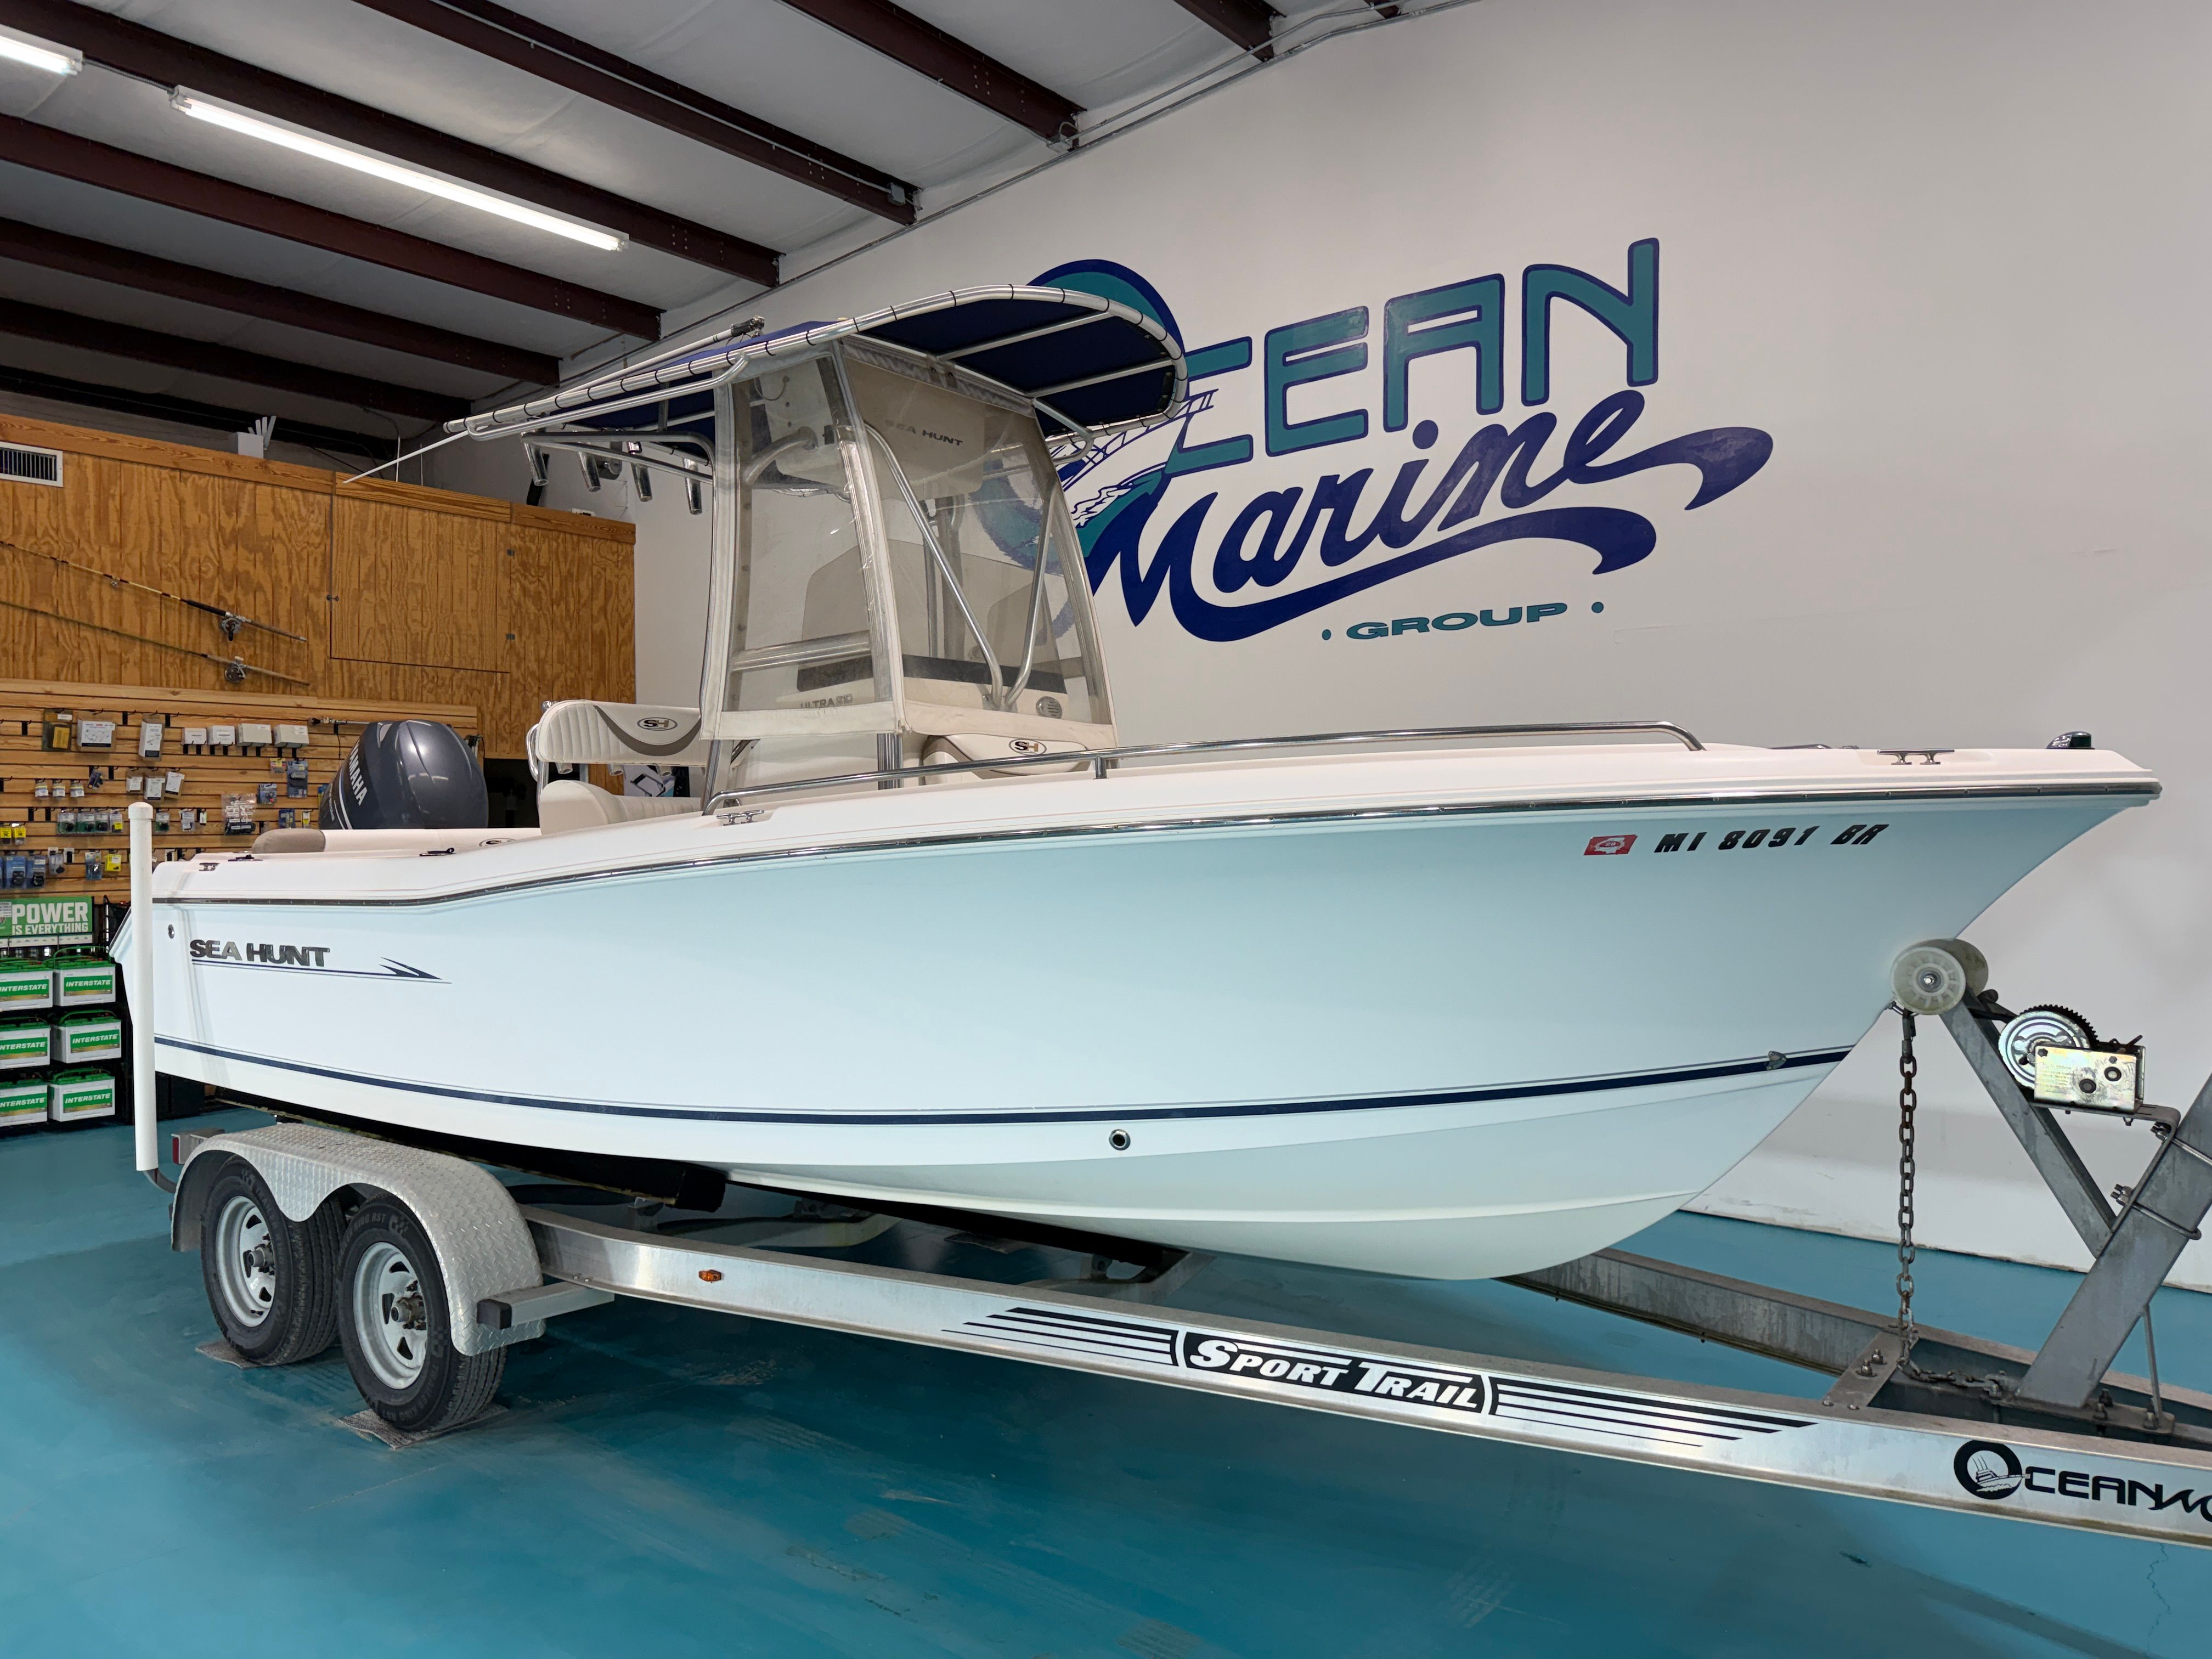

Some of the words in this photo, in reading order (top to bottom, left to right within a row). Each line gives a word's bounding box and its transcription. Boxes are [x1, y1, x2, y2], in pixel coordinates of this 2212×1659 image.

[884, 419, 916, 434] SEA
[922, 430, 963, 446] HUNT
[1089, 390, 1773, 642] Marine
[1346, 602, 1568, 640] GROUP
[348, 738, 368, 806] YAMAHA
[1654, 832, 1707, 853] MI
[1718, 826, 1820, 850] 8091
[1830, 824, 1889, 845] BR
[12, 902, 88, 924] POWER
[12, 924, 22, 935] IS
[25, 922, 89, 935] EVERYTHING
[189, 939, 242, 961] SEA
[246, 943, 330, 967] HUNT
[65, 979, 111, 988] INTERSTATE
[0, 1041, 46, 1051] NTERSTATE
[72, 1034, 118, 1044] INTERSTATE
[0, 1097, 45, 1108] NTERSTATE
[65, 1092, 111, 1104] INTERSTATE
[352, 1212, 369, 1231] KING
[371, 1213, 386, 1222] RST
[1189, 1340, 1352, 1387] SPORT
[1354, 1361, 1479, 1409] TRAIL
